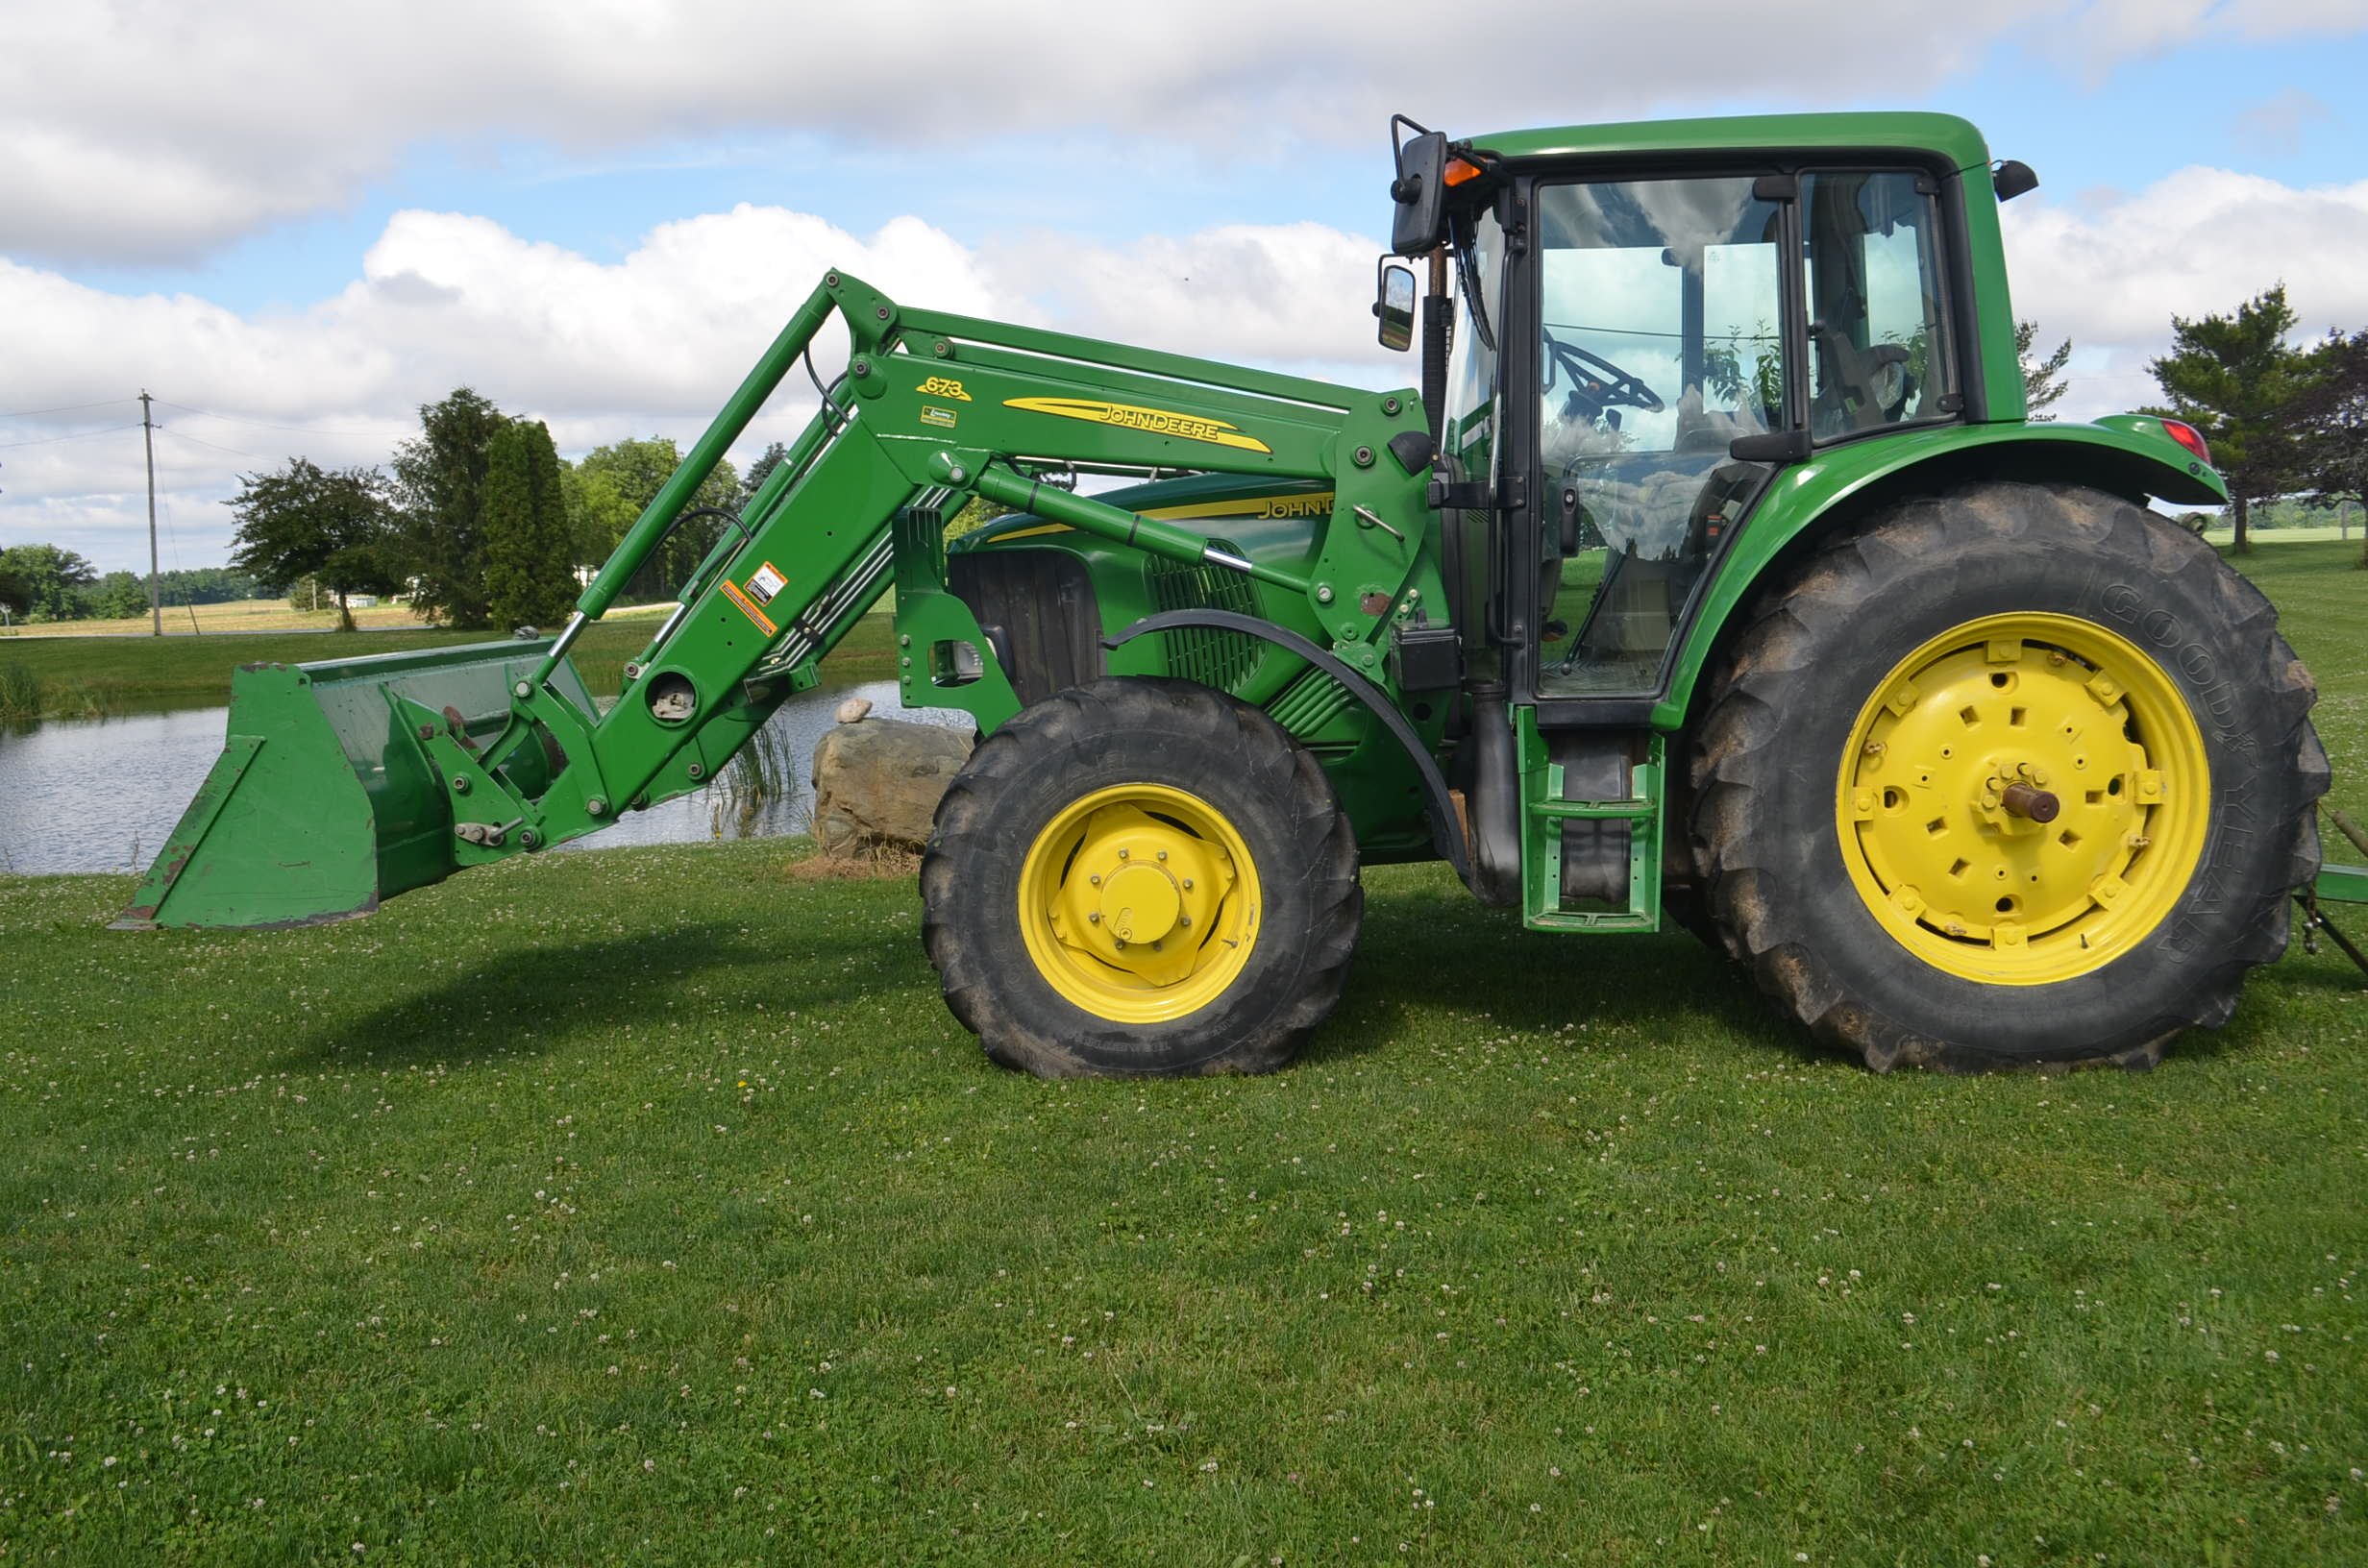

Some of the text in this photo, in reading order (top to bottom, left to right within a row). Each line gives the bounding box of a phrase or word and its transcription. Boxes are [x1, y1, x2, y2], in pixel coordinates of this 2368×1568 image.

[925, 376, 963, 397] 673
[1099, 404, 1220, 440] JOHN DEERE
[1257, 500, 1320, 519] JOHN
